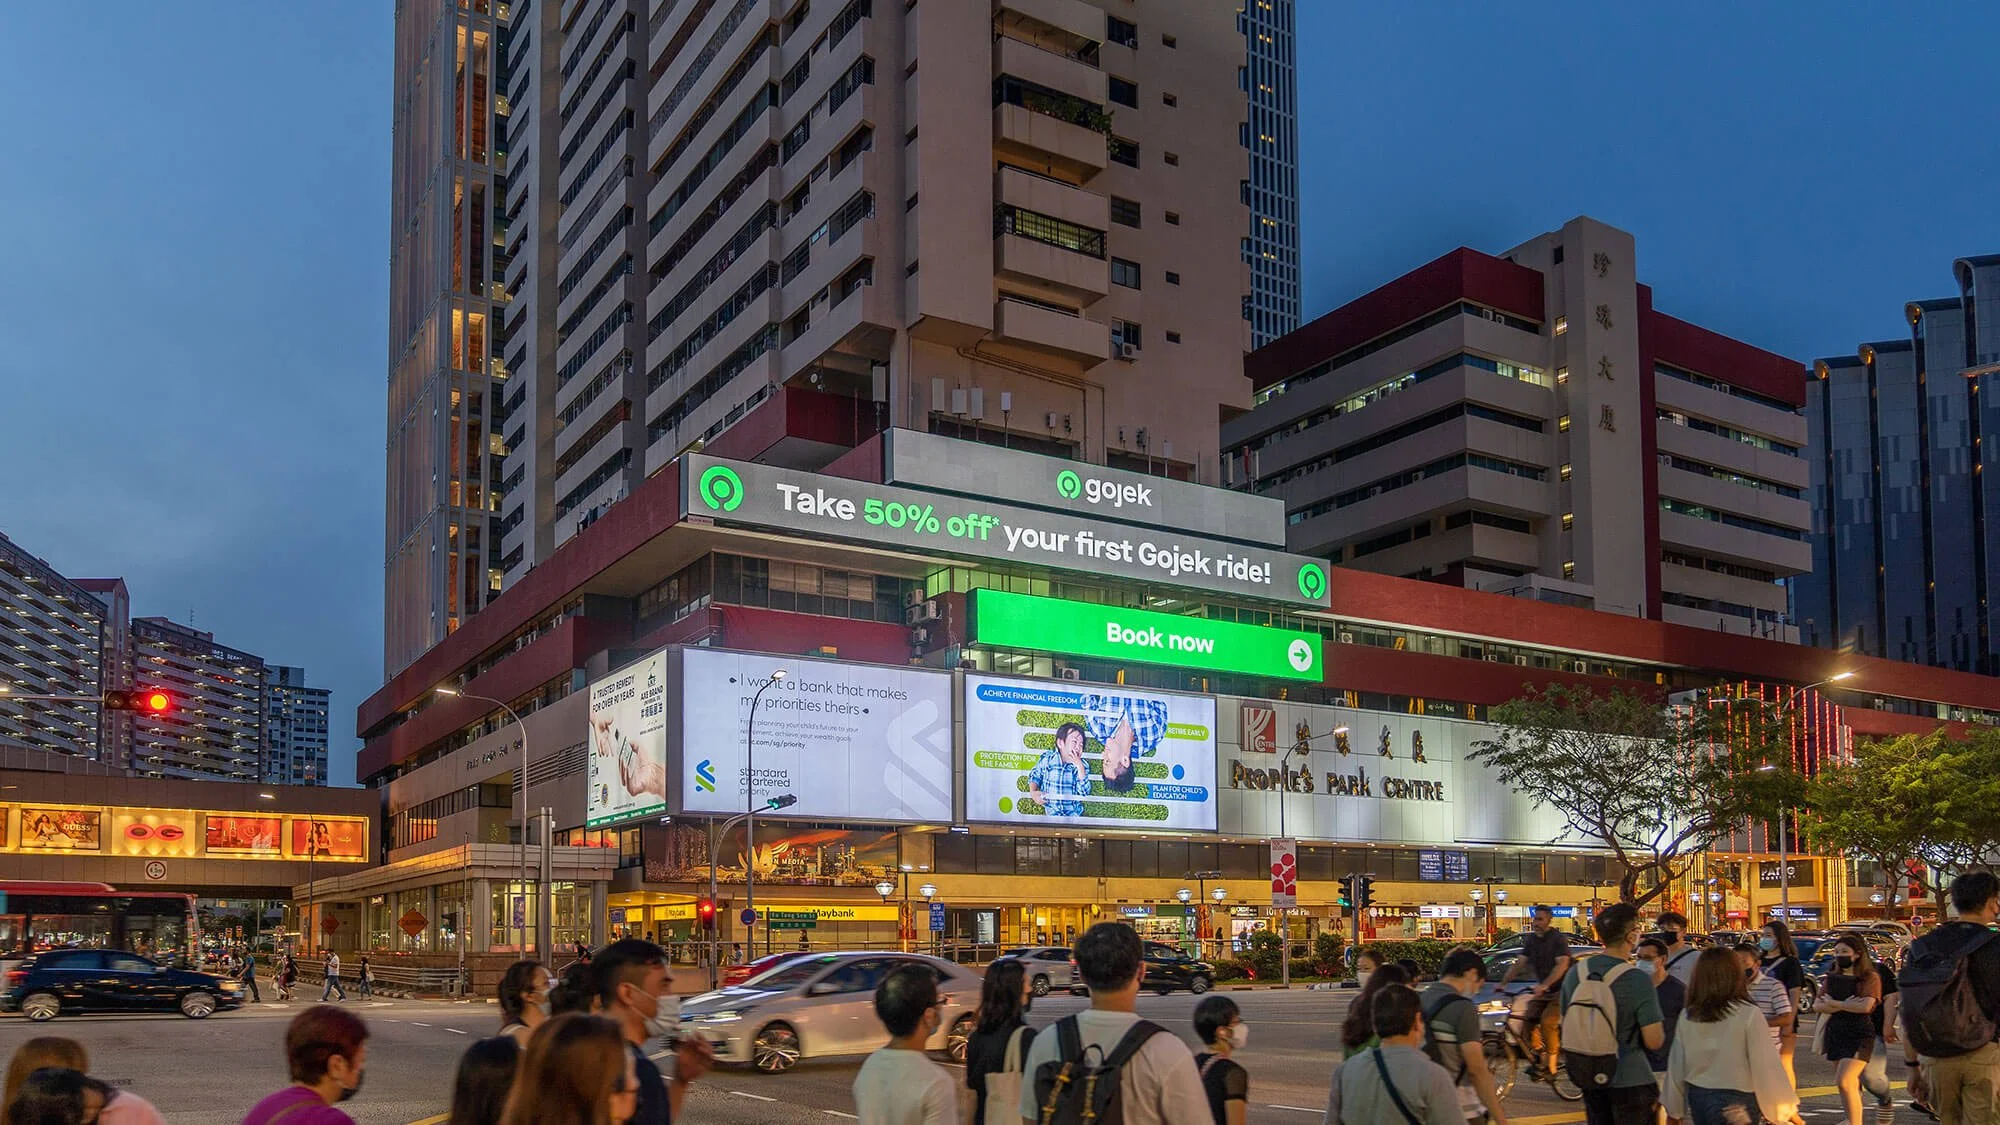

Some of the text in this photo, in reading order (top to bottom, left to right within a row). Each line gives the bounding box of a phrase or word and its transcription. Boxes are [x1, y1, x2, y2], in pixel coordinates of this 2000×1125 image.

[1085, 478, 1153, 508] gojek
[776, 483, 856, 521] Take
[863, 498, 941, 534] 50%
[1003, 524, 1070, 553] your
[1074, 530, 1133, 563] first
[1138, 542, 1211, 577] Gojek
[1216, 553, 1271, 585] ride!
[1107, 622, 1214, 653] Book now
[597, 683, 615, 699] TRUSTED
[616, 674, 635, 690] REMEDY
[640, 685, 663, 701] AXE BRAND
[741, 674, 908, 701] I want a bank that makes
[592, 688, 635, 713] FOR OVER 90 YEARS
[983, 689, 1078, 704] ACHIEVE FINANCIAL FREEDOM
[765, 697, 821, 714] priorities
[825, 701, 860, 716] theirs
[757, 719, 785, 730] planning
[785, 721, 800, 730] your
[820, 723, 838, 732] future
[1167, 727, 1206, 737] RETIRE EARLY
[774, 730, 799, 739] achieve
[799, 732, 813, 741] your
[814, 733, 834, 742] wealth
[750, 738, 806, 750] c.com/sg/priority
[980, 751, 1036, 762] PROTECTION FOR
[980, 760, 1020, 769] THE FAMILY
[1152, 784, 1204, 794] PLAN FOR CHILD'S
[1152, 791, 1188, 800] EDUCATION
[1381, 776, 1444, 801] CENTRE
[63, 823, 91, 831] GUESS
[812, 908, 855, 918] Maybank
